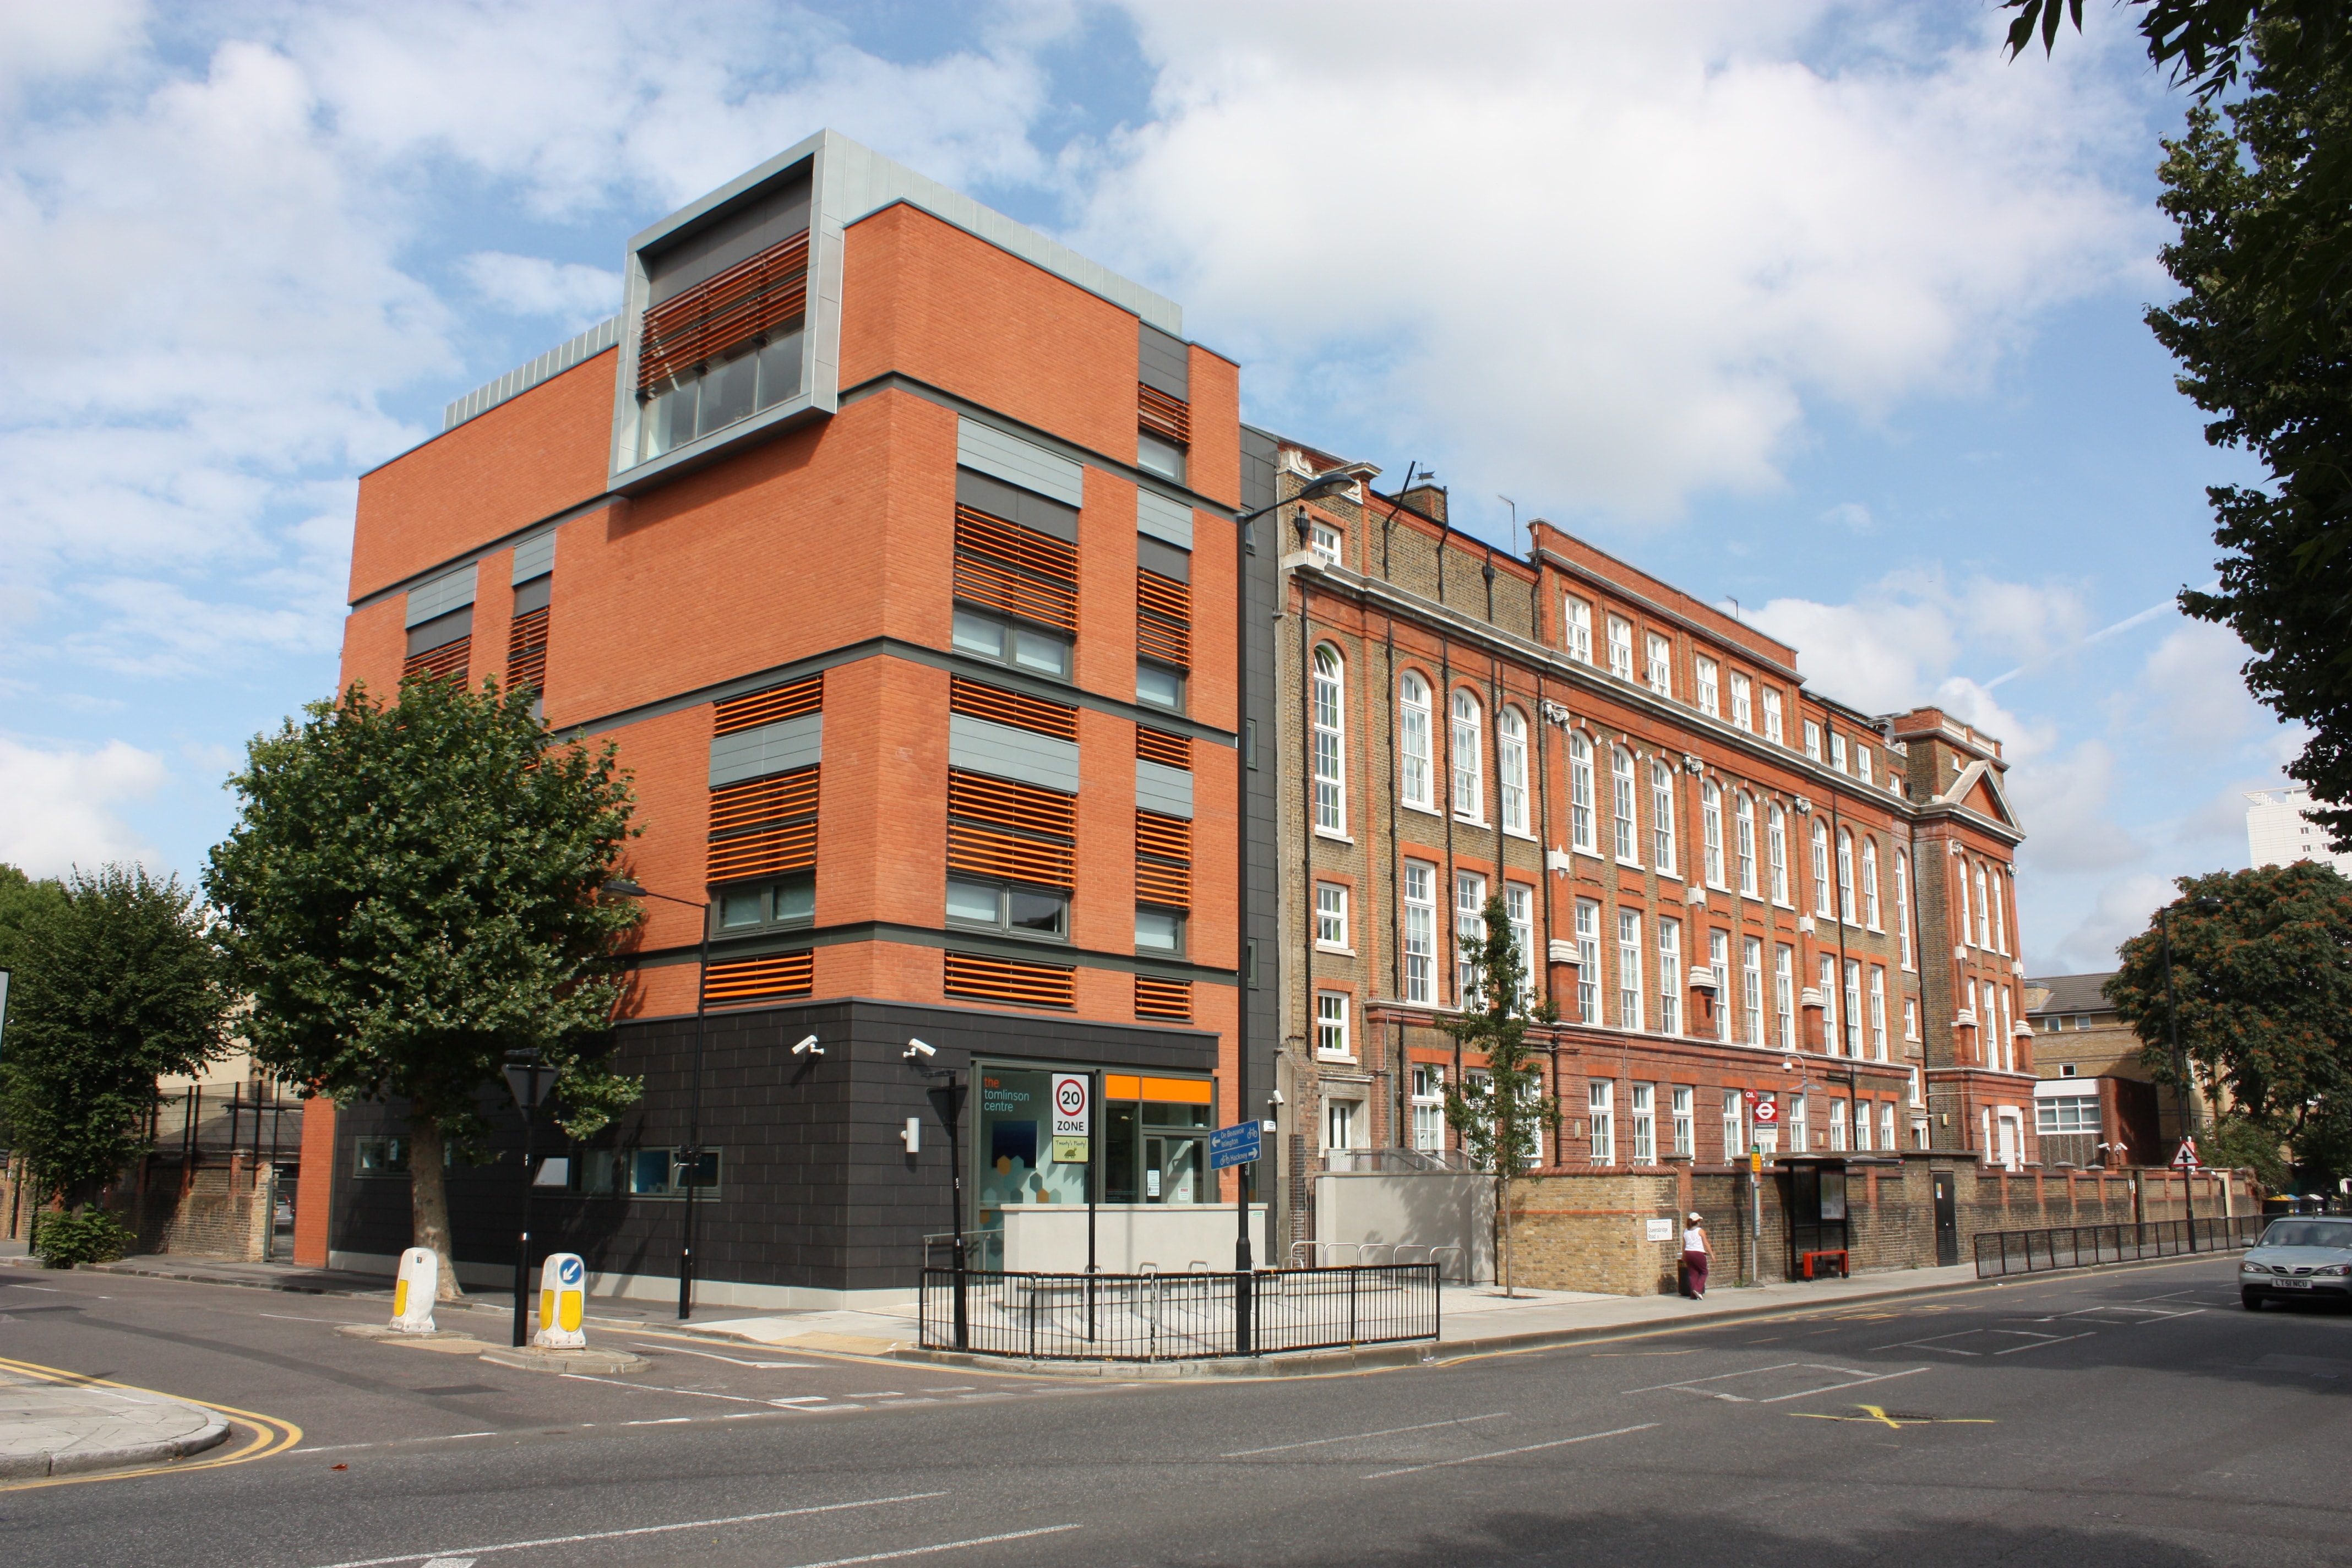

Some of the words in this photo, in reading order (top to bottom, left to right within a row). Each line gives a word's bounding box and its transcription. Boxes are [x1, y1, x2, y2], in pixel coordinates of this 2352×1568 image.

[984, 1077, 1000, 1088] the
[984, 1089, 1029, 1101] tomlinson
[1062, 1091, 1080, 1105] 20
[984, 1101, 1013, 1112] centre
[1057, 1121, 1084, 1131] ZONE
[1227, 1128, 1244, 1137] Beauvoir
[1221, 1139, 1239, 1147] Islington
[1230, 1153, 1248, 1162] Hackney
